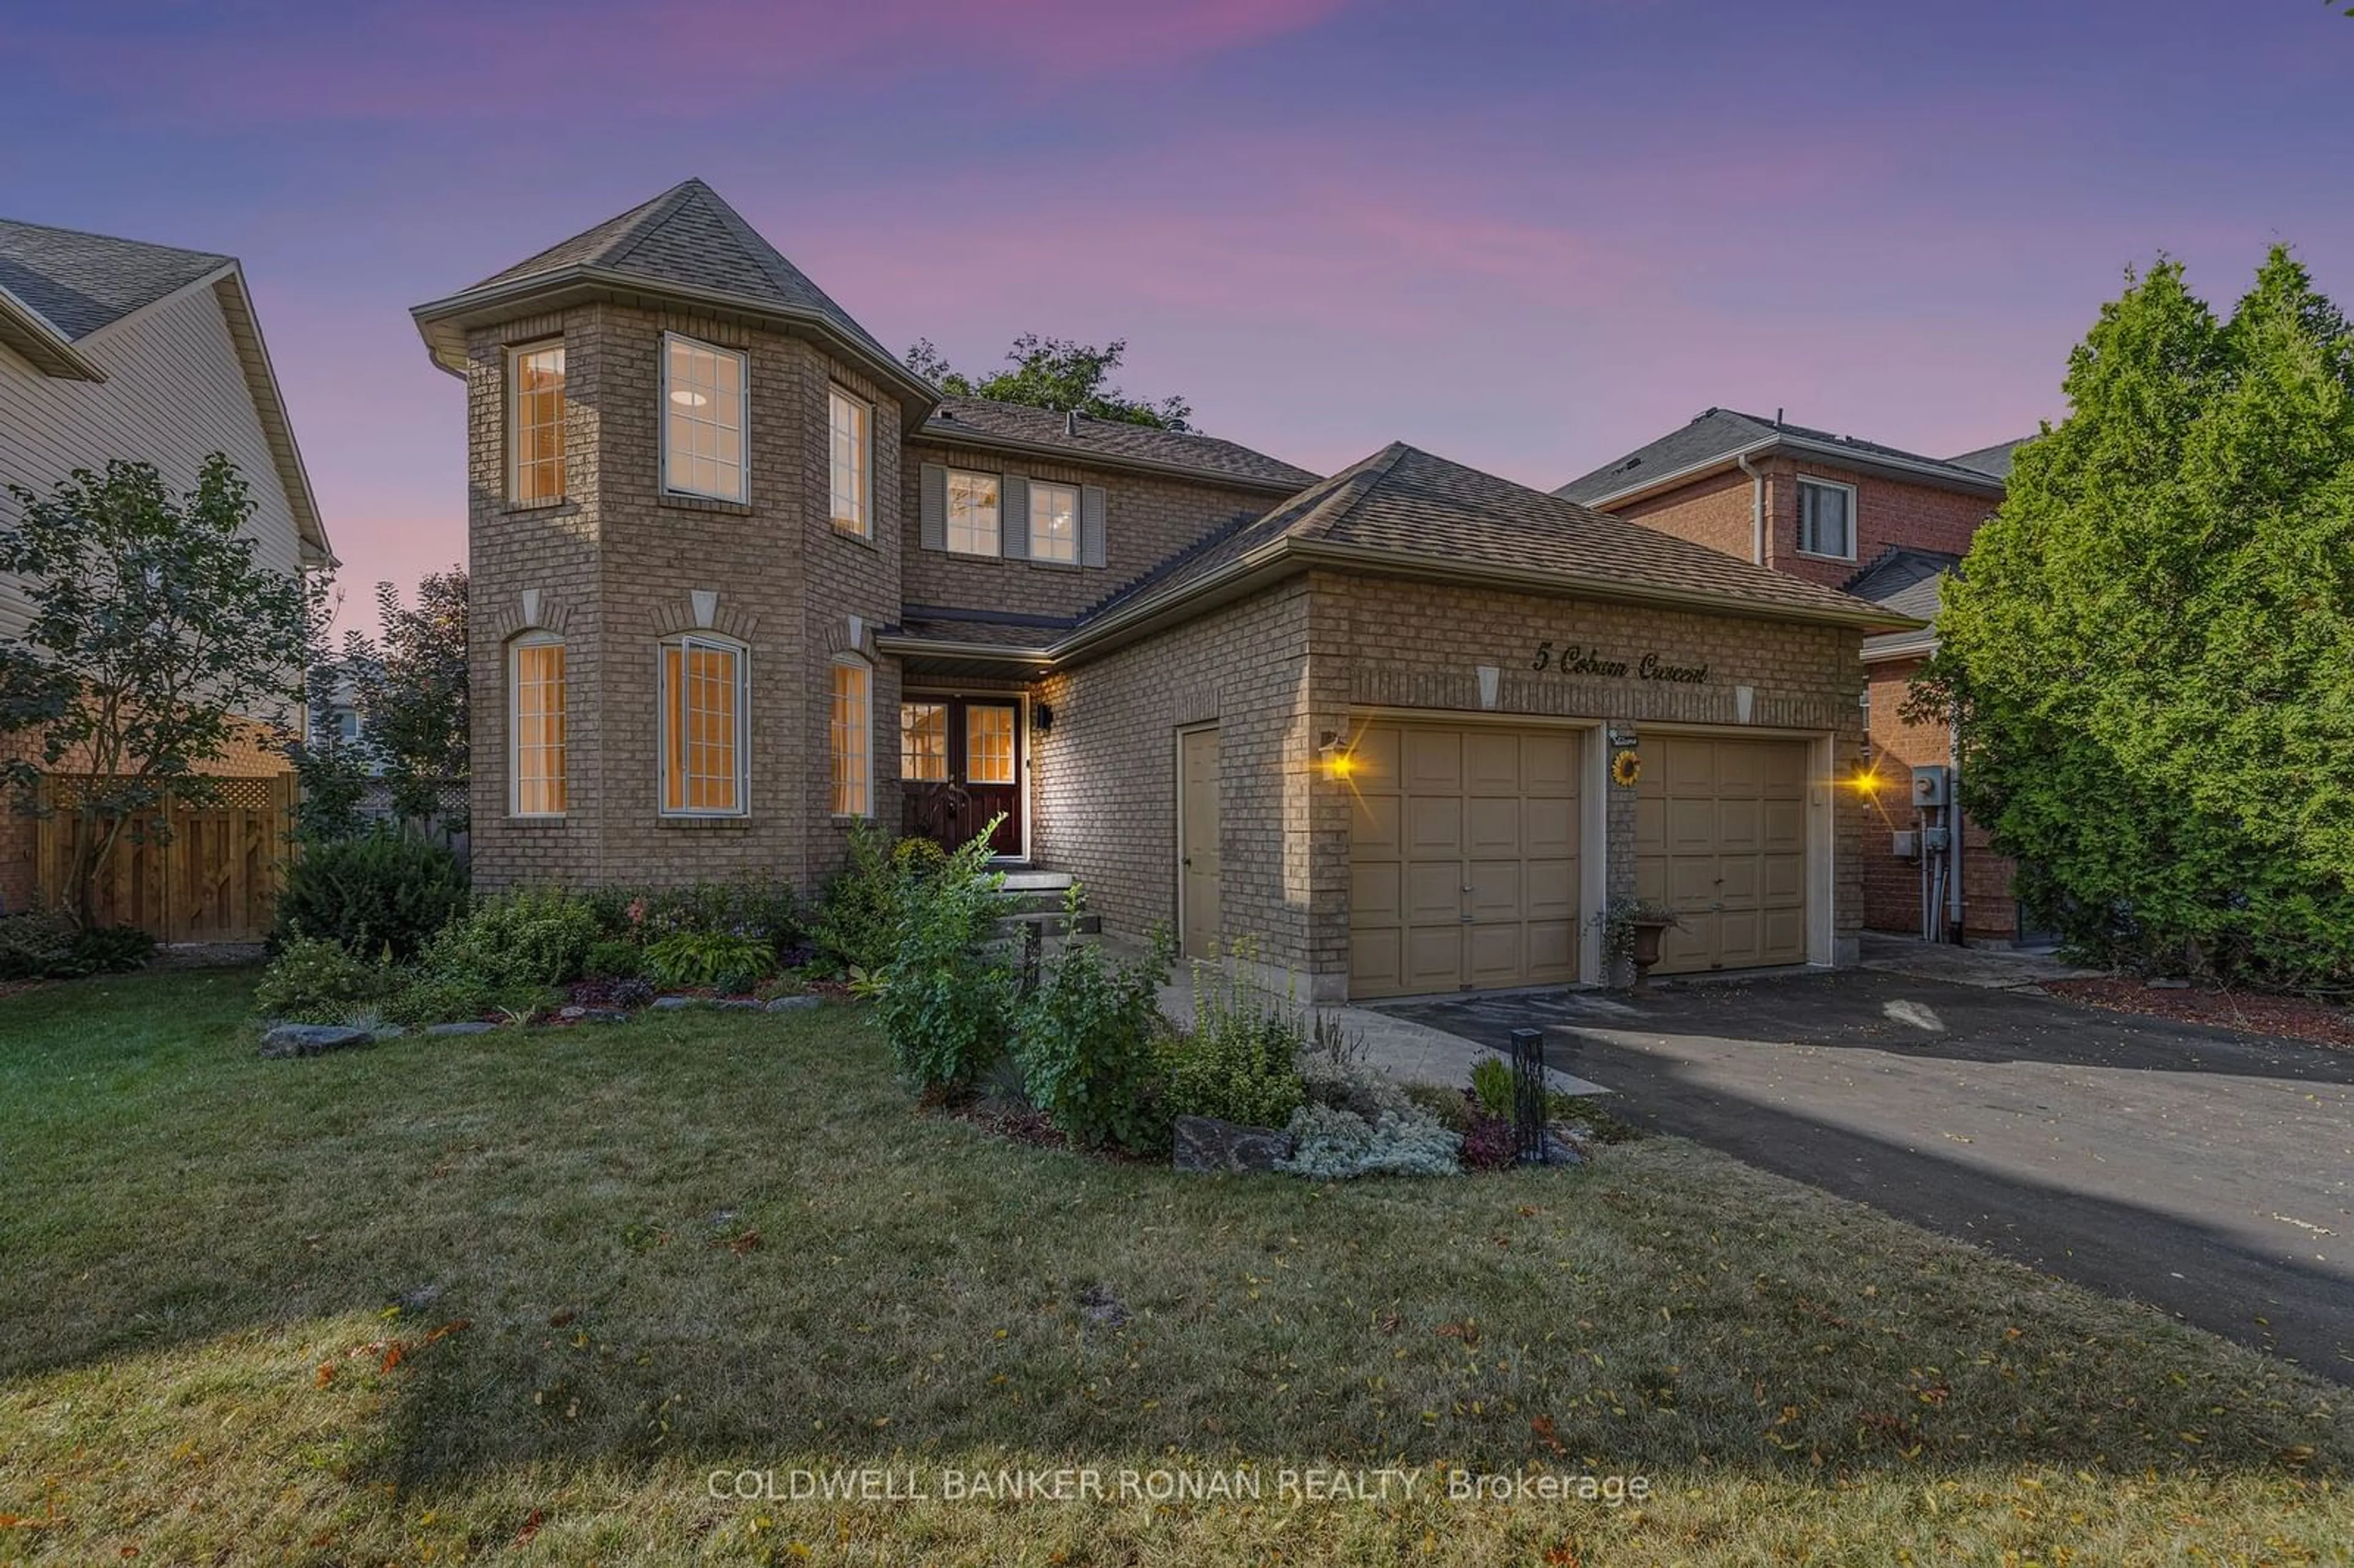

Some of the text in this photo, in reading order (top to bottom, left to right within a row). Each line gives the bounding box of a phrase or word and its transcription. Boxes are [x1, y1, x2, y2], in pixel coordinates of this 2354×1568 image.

[1533, 642, 1708, 683] 5 Coburn Crescent
